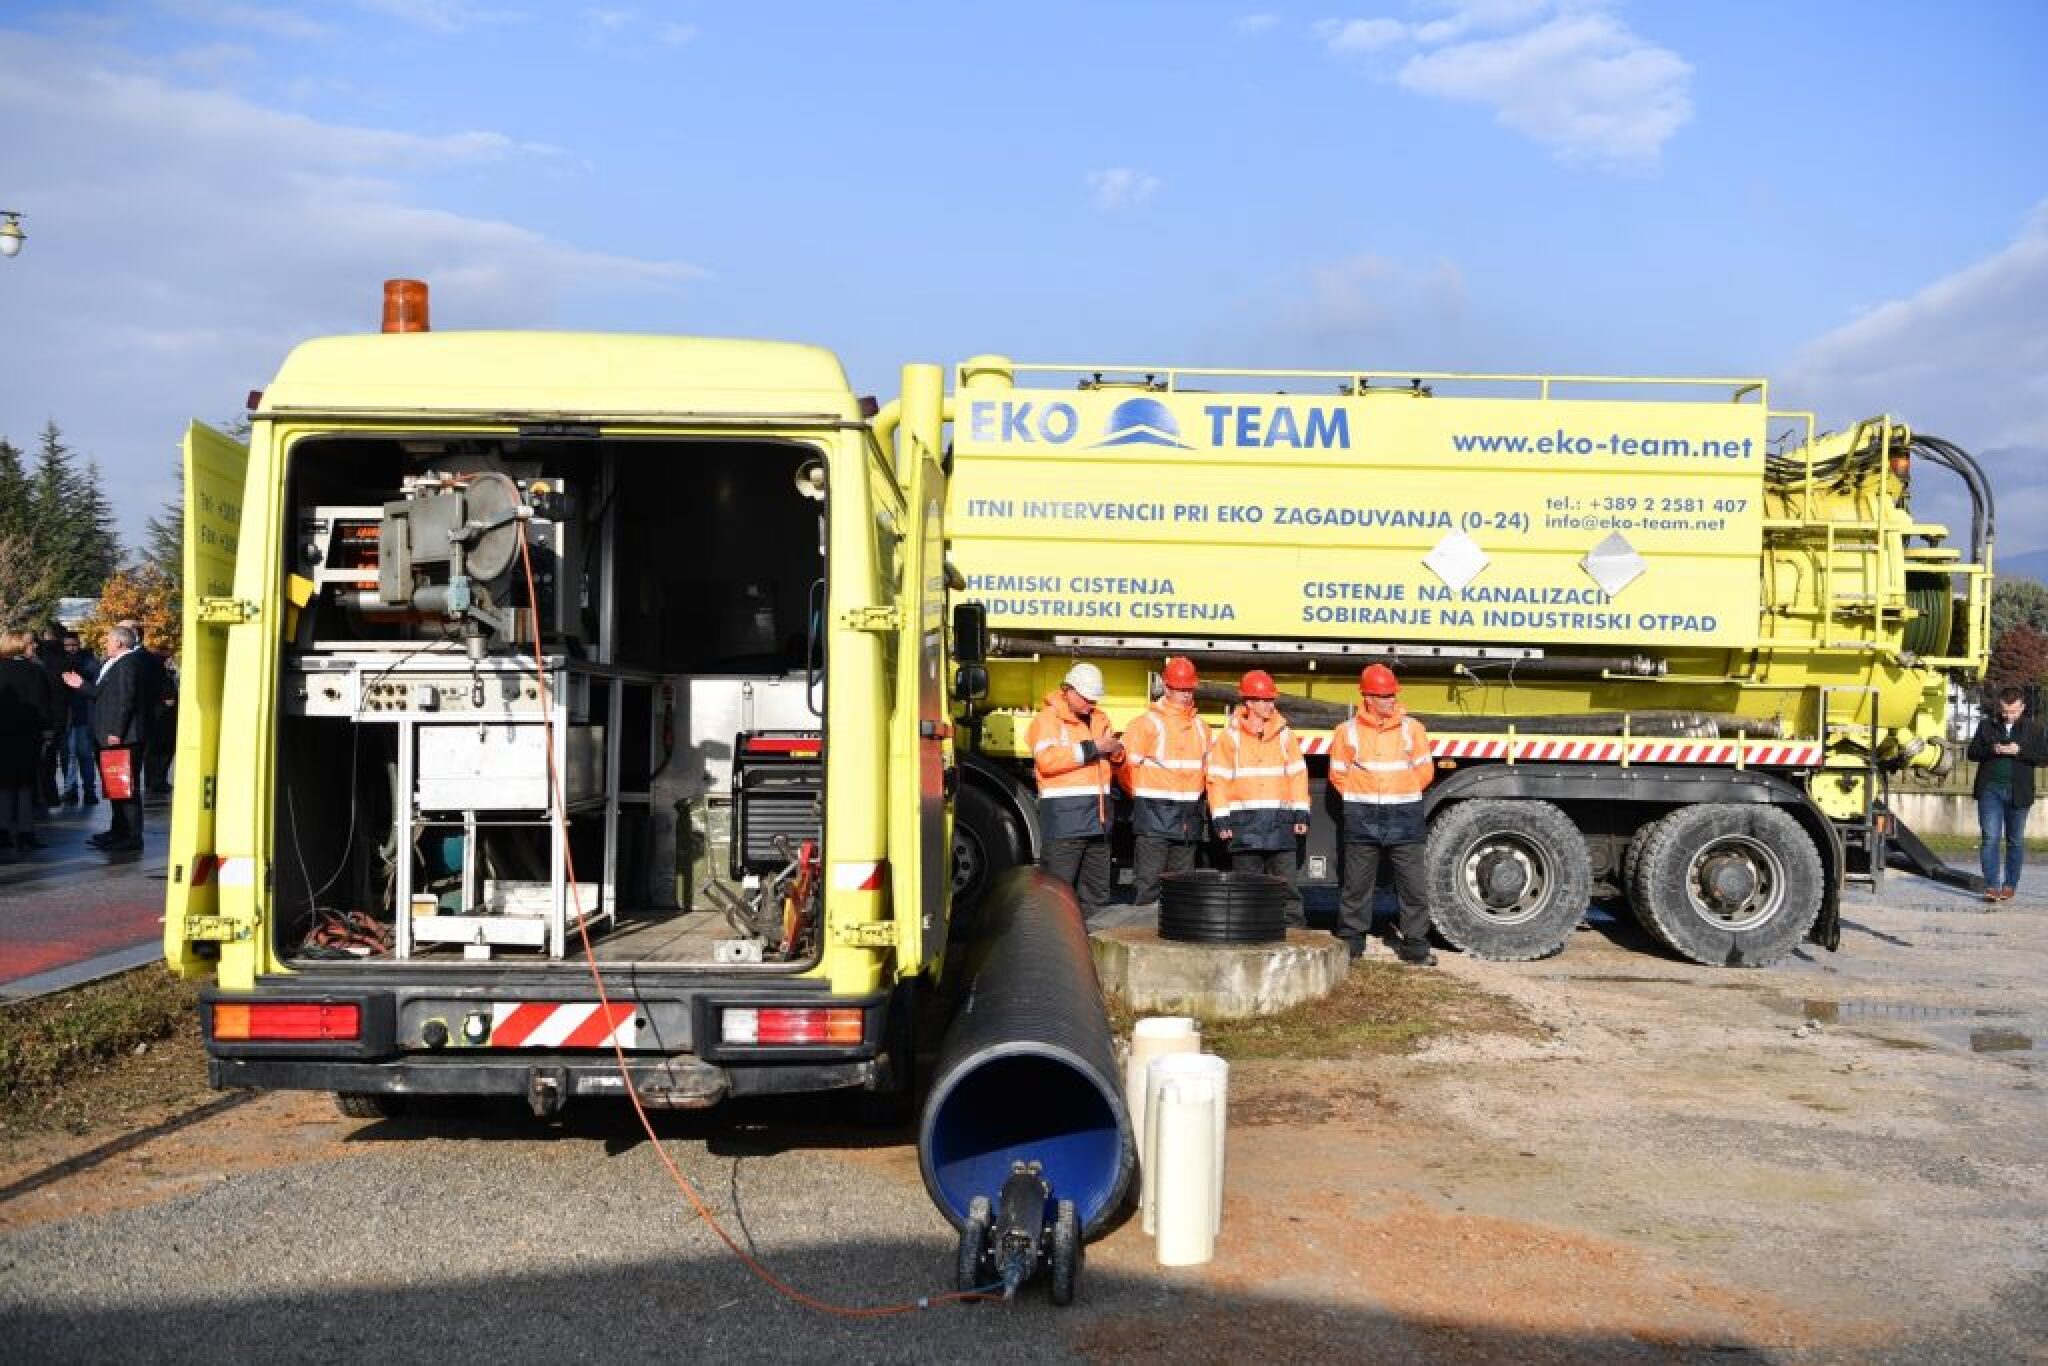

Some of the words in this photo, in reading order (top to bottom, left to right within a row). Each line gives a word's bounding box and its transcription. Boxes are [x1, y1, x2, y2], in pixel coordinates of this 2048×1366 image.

[971, 401, 1079, 444] EKO
[1204, 406, 1351, 448] TEAM
[1452, 430, 1753, 459] www.eko-team.net
[1546, 496, 1580, 511] tel.:
[1590, 497, 1636, 511] +389
[1644, 498, 1654, 511] 2
[1661, 498, 1705, 512] 2581
[1713, 499, 1747, 513] 407
[967, 500, 1013, 518] ITNI
[1023, 502, 1165, 521] INTERVENCII
[1174, 504, 1208, 522] PRI
[1217, 506, 1263, 524] EKO
[1273, 508, 1453, 529] ZAGADUVANJA
[1461, 511, 1529, 534] (0-24)
[1545, 513, 1725, 531] info@eko-team.net
[967, 574, 1061, 593] HEMISKI
[1070, 577, 1175, 595] CISTENJA
[1303, 582, 1405, 601] CISTENJE
[1418, 585, 1453, 602] NA
[1130, 602, 1236, 621] CISTENJA
[1302, 606, 1431, 625] SOBIRANJE
[1440, 609, 1475, 626] NA
[1484, 610, 1631, 630] INDUSTRISKI
[1638, 614, 1717, 633] OTPAD
